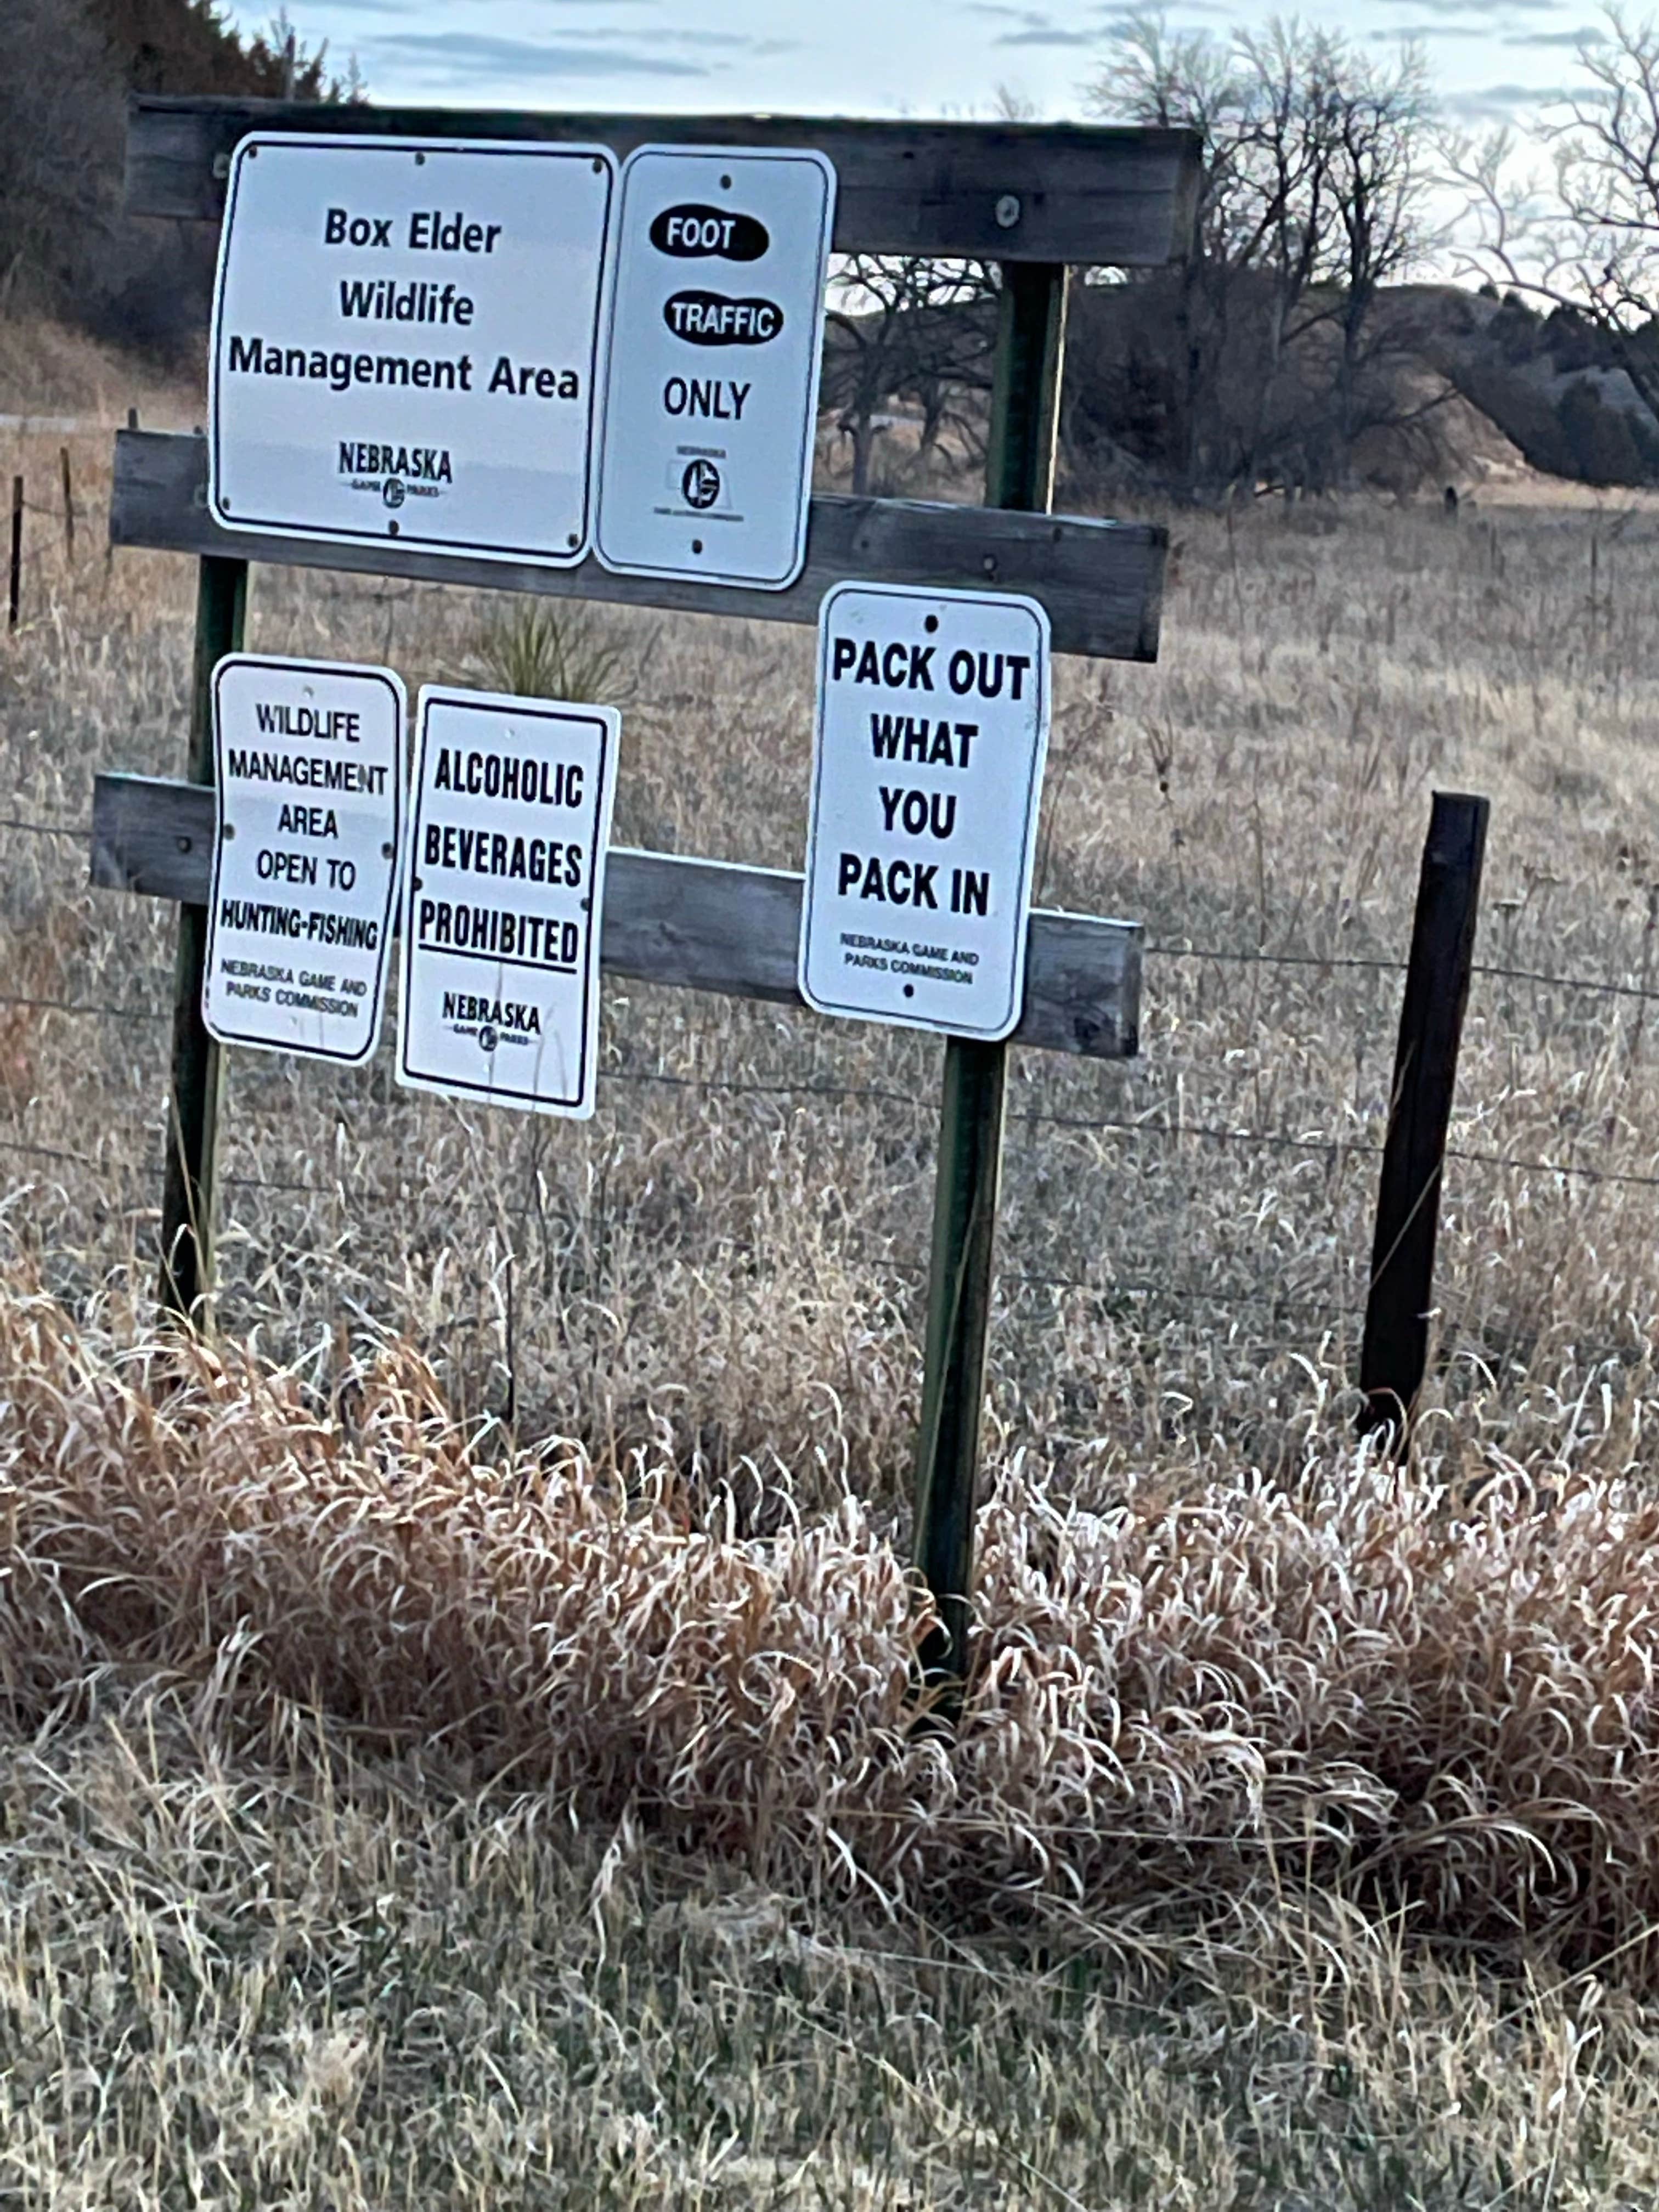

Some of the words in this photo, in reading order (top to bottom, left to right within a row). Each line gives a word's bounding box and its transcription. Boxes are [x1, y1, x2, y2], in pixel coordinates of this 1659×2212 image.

[325, 208, 392, 247] Box
[409, 211, 502, 253] Elder
[667, 217, 735, 249] FOOT
[340, 281, 474, 325] Wildlife
[672, 302, 774, 337] TRAFFIC
[229, 336, 472, 391] Management
[488, 357, 578, 399] Area
[664, 377, 751, 420] ONLY
[339, 441, 452, 483] NEBRASKA
[833, 639, 935, 691] PACK
[949, 650, 1030, 699] OUT
[256, 703, 359, 742] WILDLIFE
[870, 713, 979, 768] WHAT
[229, 748, 388, 795] MANAGEMENT
[435, 748, 583, 808] ALCOHOLIC
[278, 804, 338, 839] AREA
[879, 787, 956, 839] YOU
[257, 849, 316, 884] OPEN
[326, 859, 356, 891] TO
[425, 825, 580, 887] BEVERAGES
[838, 853, 937, 909] PACK
[951, 868, 989, 916] IN
[221, 899, 377, 950] HUNTING-FISHING
[420, 900, 578, 963] PROHIBITED
[840, 933, 910, 955] NEBRASKA
[912, 944, 948, 961] GAME
[951, 950, 979, 966] AND
[844, 952, 888, 970] PARKS
[891, 960, 973, 984] COMMISSION
[221, 958, 293, 984] NEBRASKA
[300, 970, 335, 991] GAME
[340, 979, 367, 997] AND
[226, 981, 271, 1002] PARKS
[276, 989, 358, 1017] COMMISSION
[442, 991, 540, 1035] NEBRASKA
